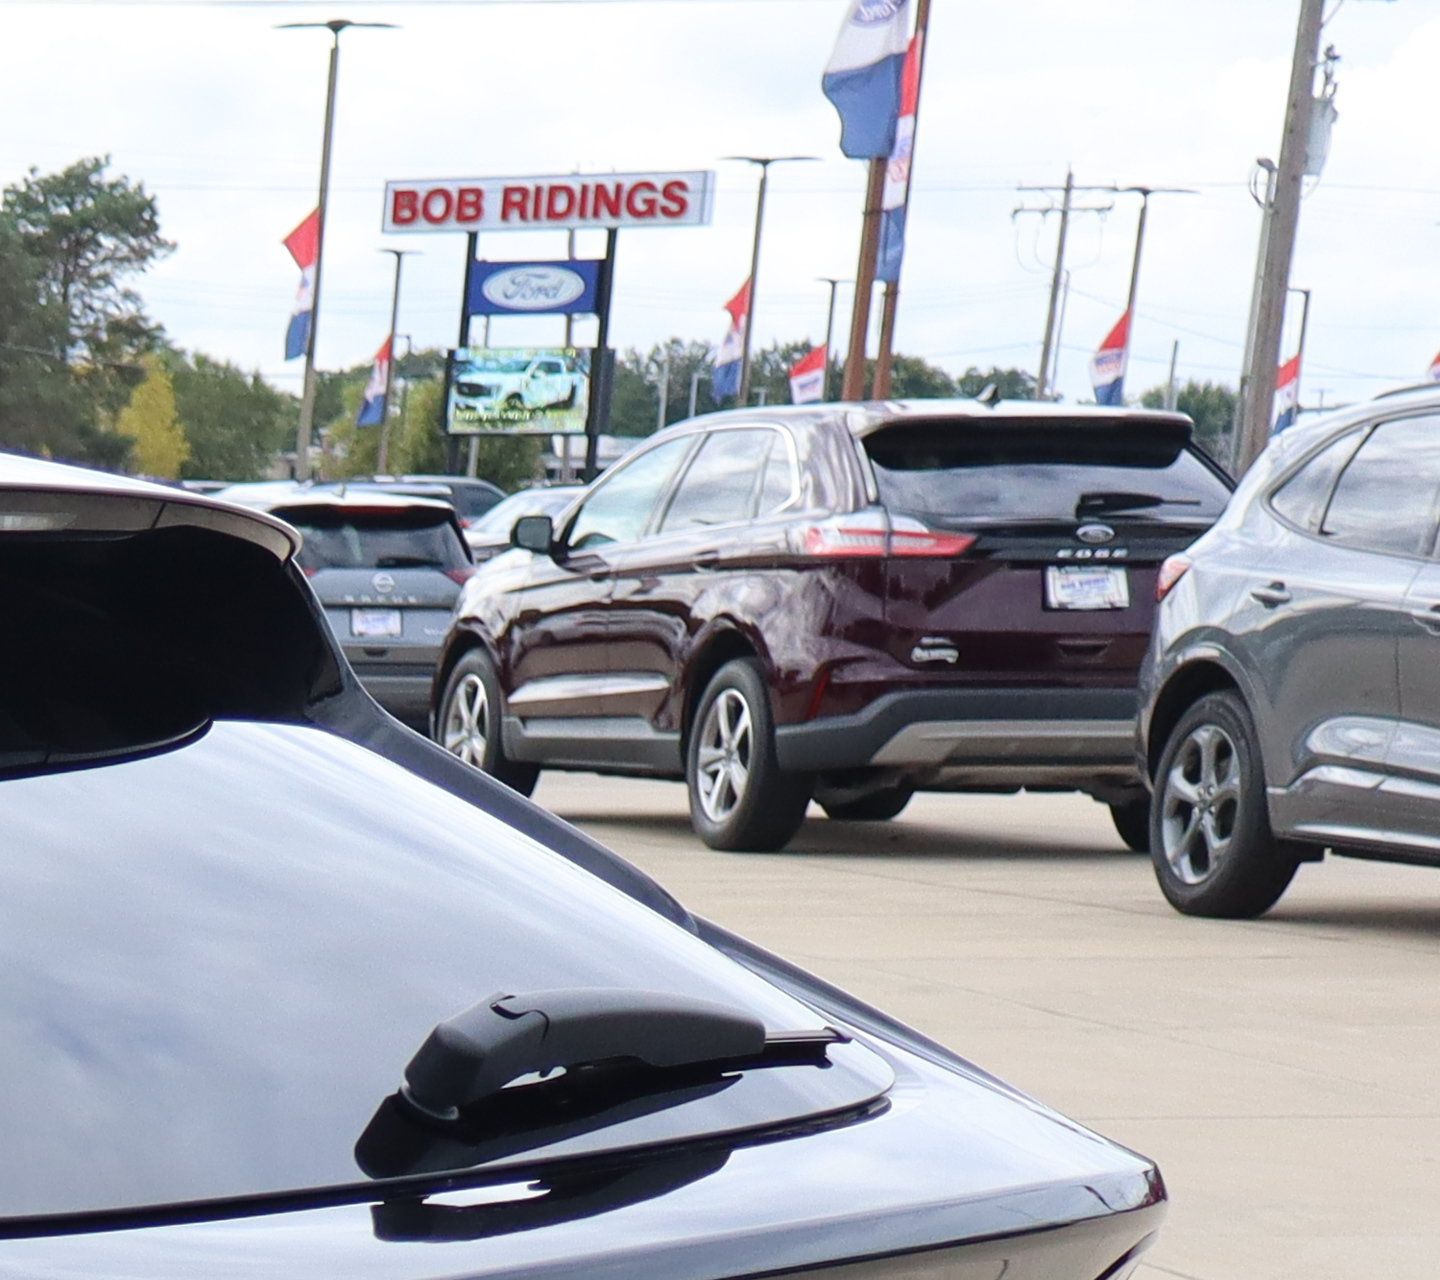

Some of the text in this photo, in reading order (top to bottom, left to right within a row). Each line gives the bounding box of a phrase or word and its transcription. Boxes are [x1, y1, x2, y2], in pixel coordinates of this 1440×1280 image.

[392, 180, 690, 225] BOB RIDINGS
[502, 272, 565, 300] Ford
